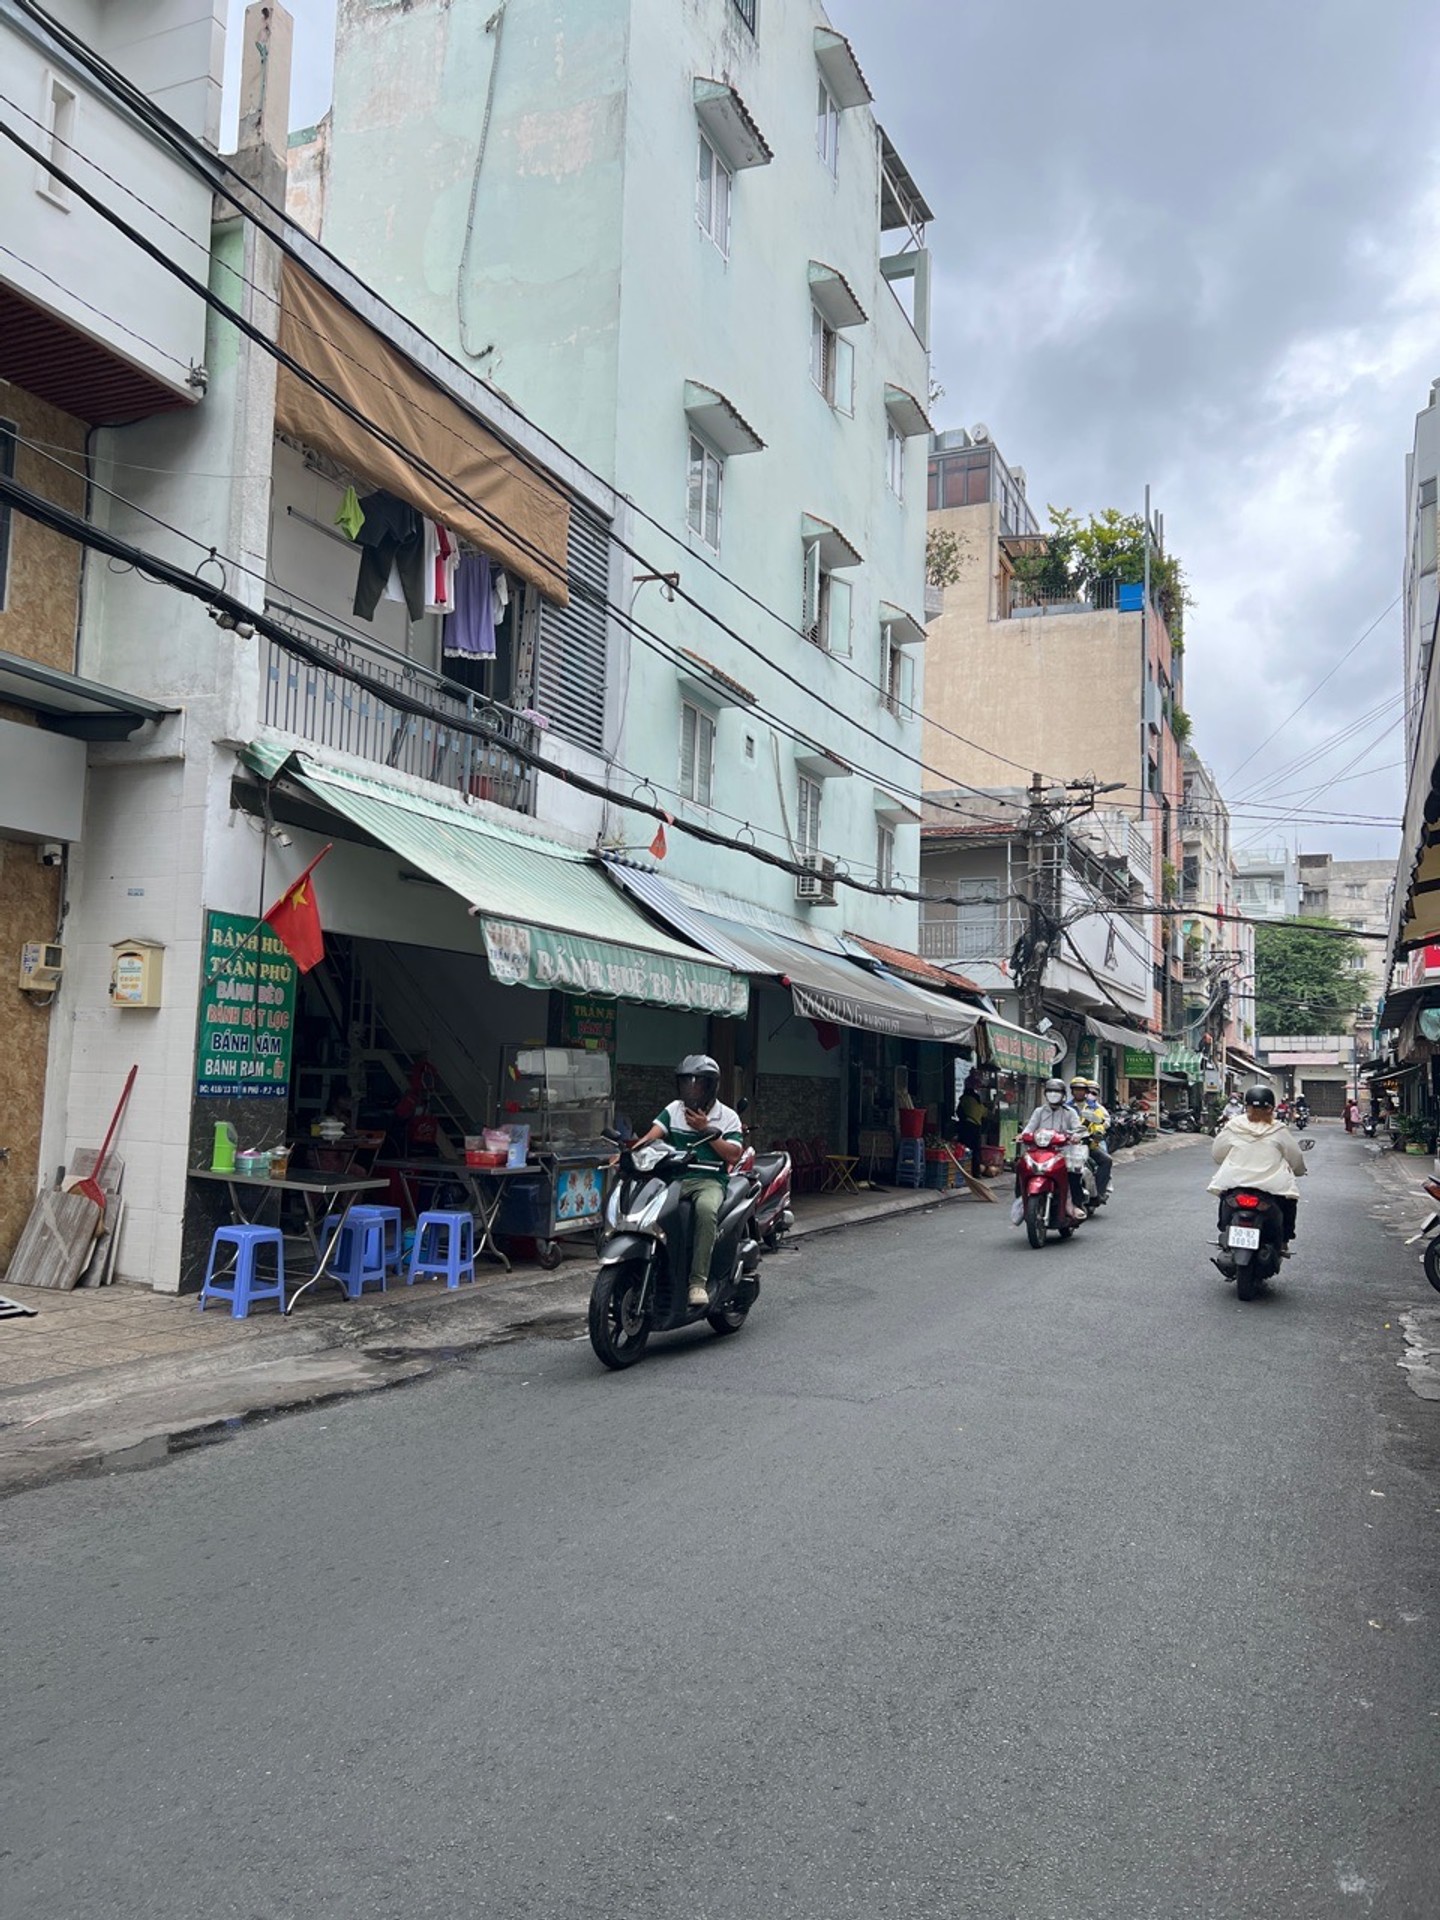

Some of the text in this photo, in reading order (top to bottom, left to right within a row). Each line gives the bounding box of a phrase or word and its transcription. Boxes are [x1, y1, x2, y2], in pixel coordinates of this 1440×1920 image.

[216, 977, 284, 1005] BÁNH BÈO
[606, 957, 648, 998] HUẾ
[650, 964, 699, 1004] TRẦN
[207, 1001, 240, 1025] BÁNH
[267, 1009, 289, 1031] LỌC
[212, 1028, 282, 1058] BÁNH NẬM
[205, 1055, 237, 1076] BÁNH
[240, 1060, 264, 1077] RAM
